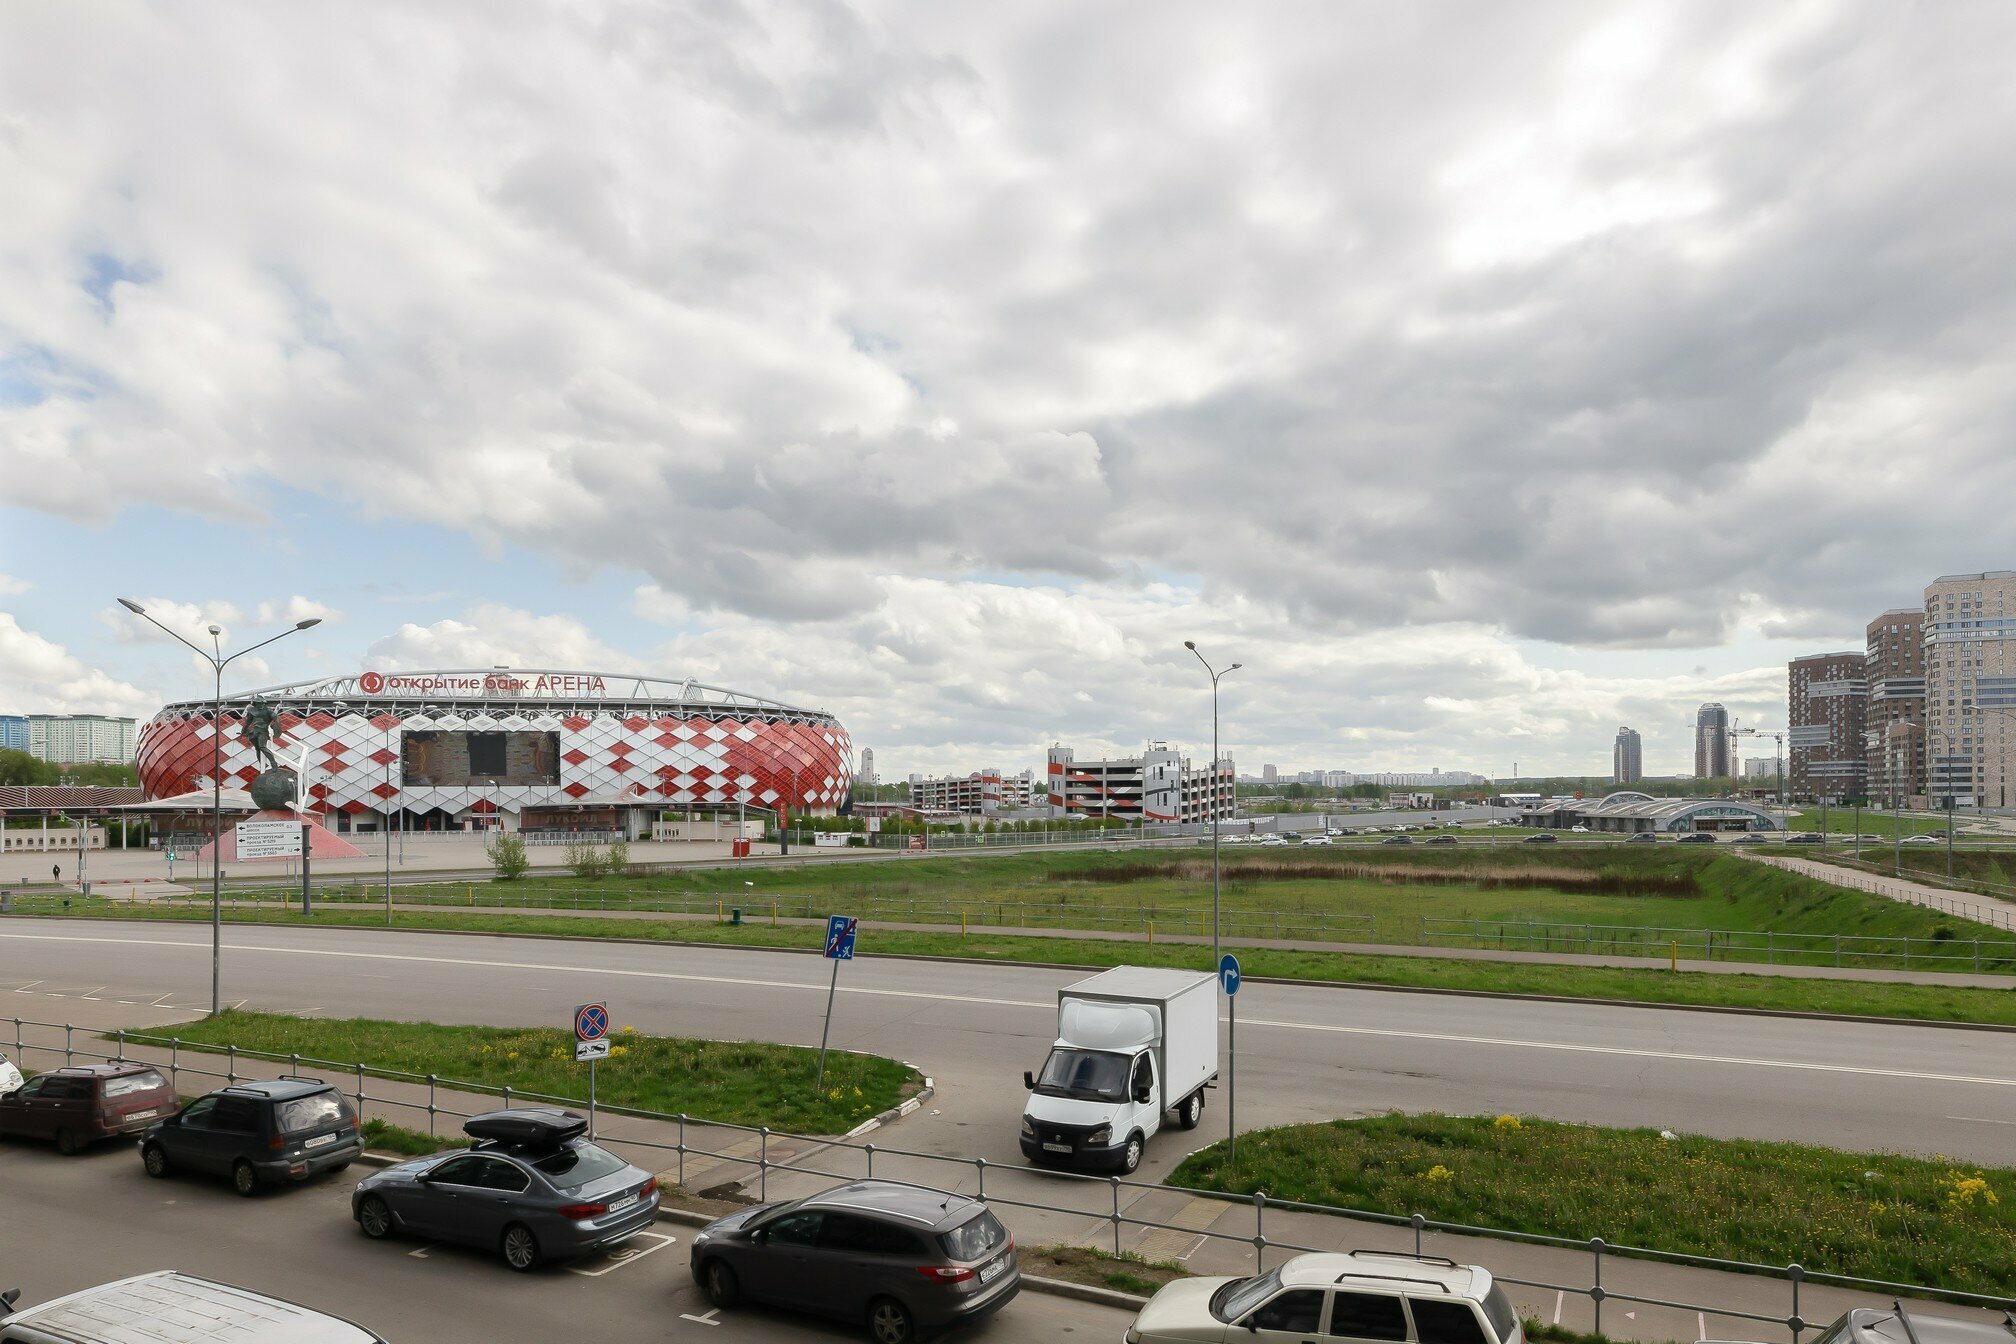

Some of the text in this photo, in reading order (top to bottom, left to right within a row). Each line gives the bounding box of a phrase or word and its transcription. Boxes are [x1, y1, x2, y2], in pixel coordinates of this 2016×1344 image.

[389, 673, 605, 693] открытие банк АРЕНА
